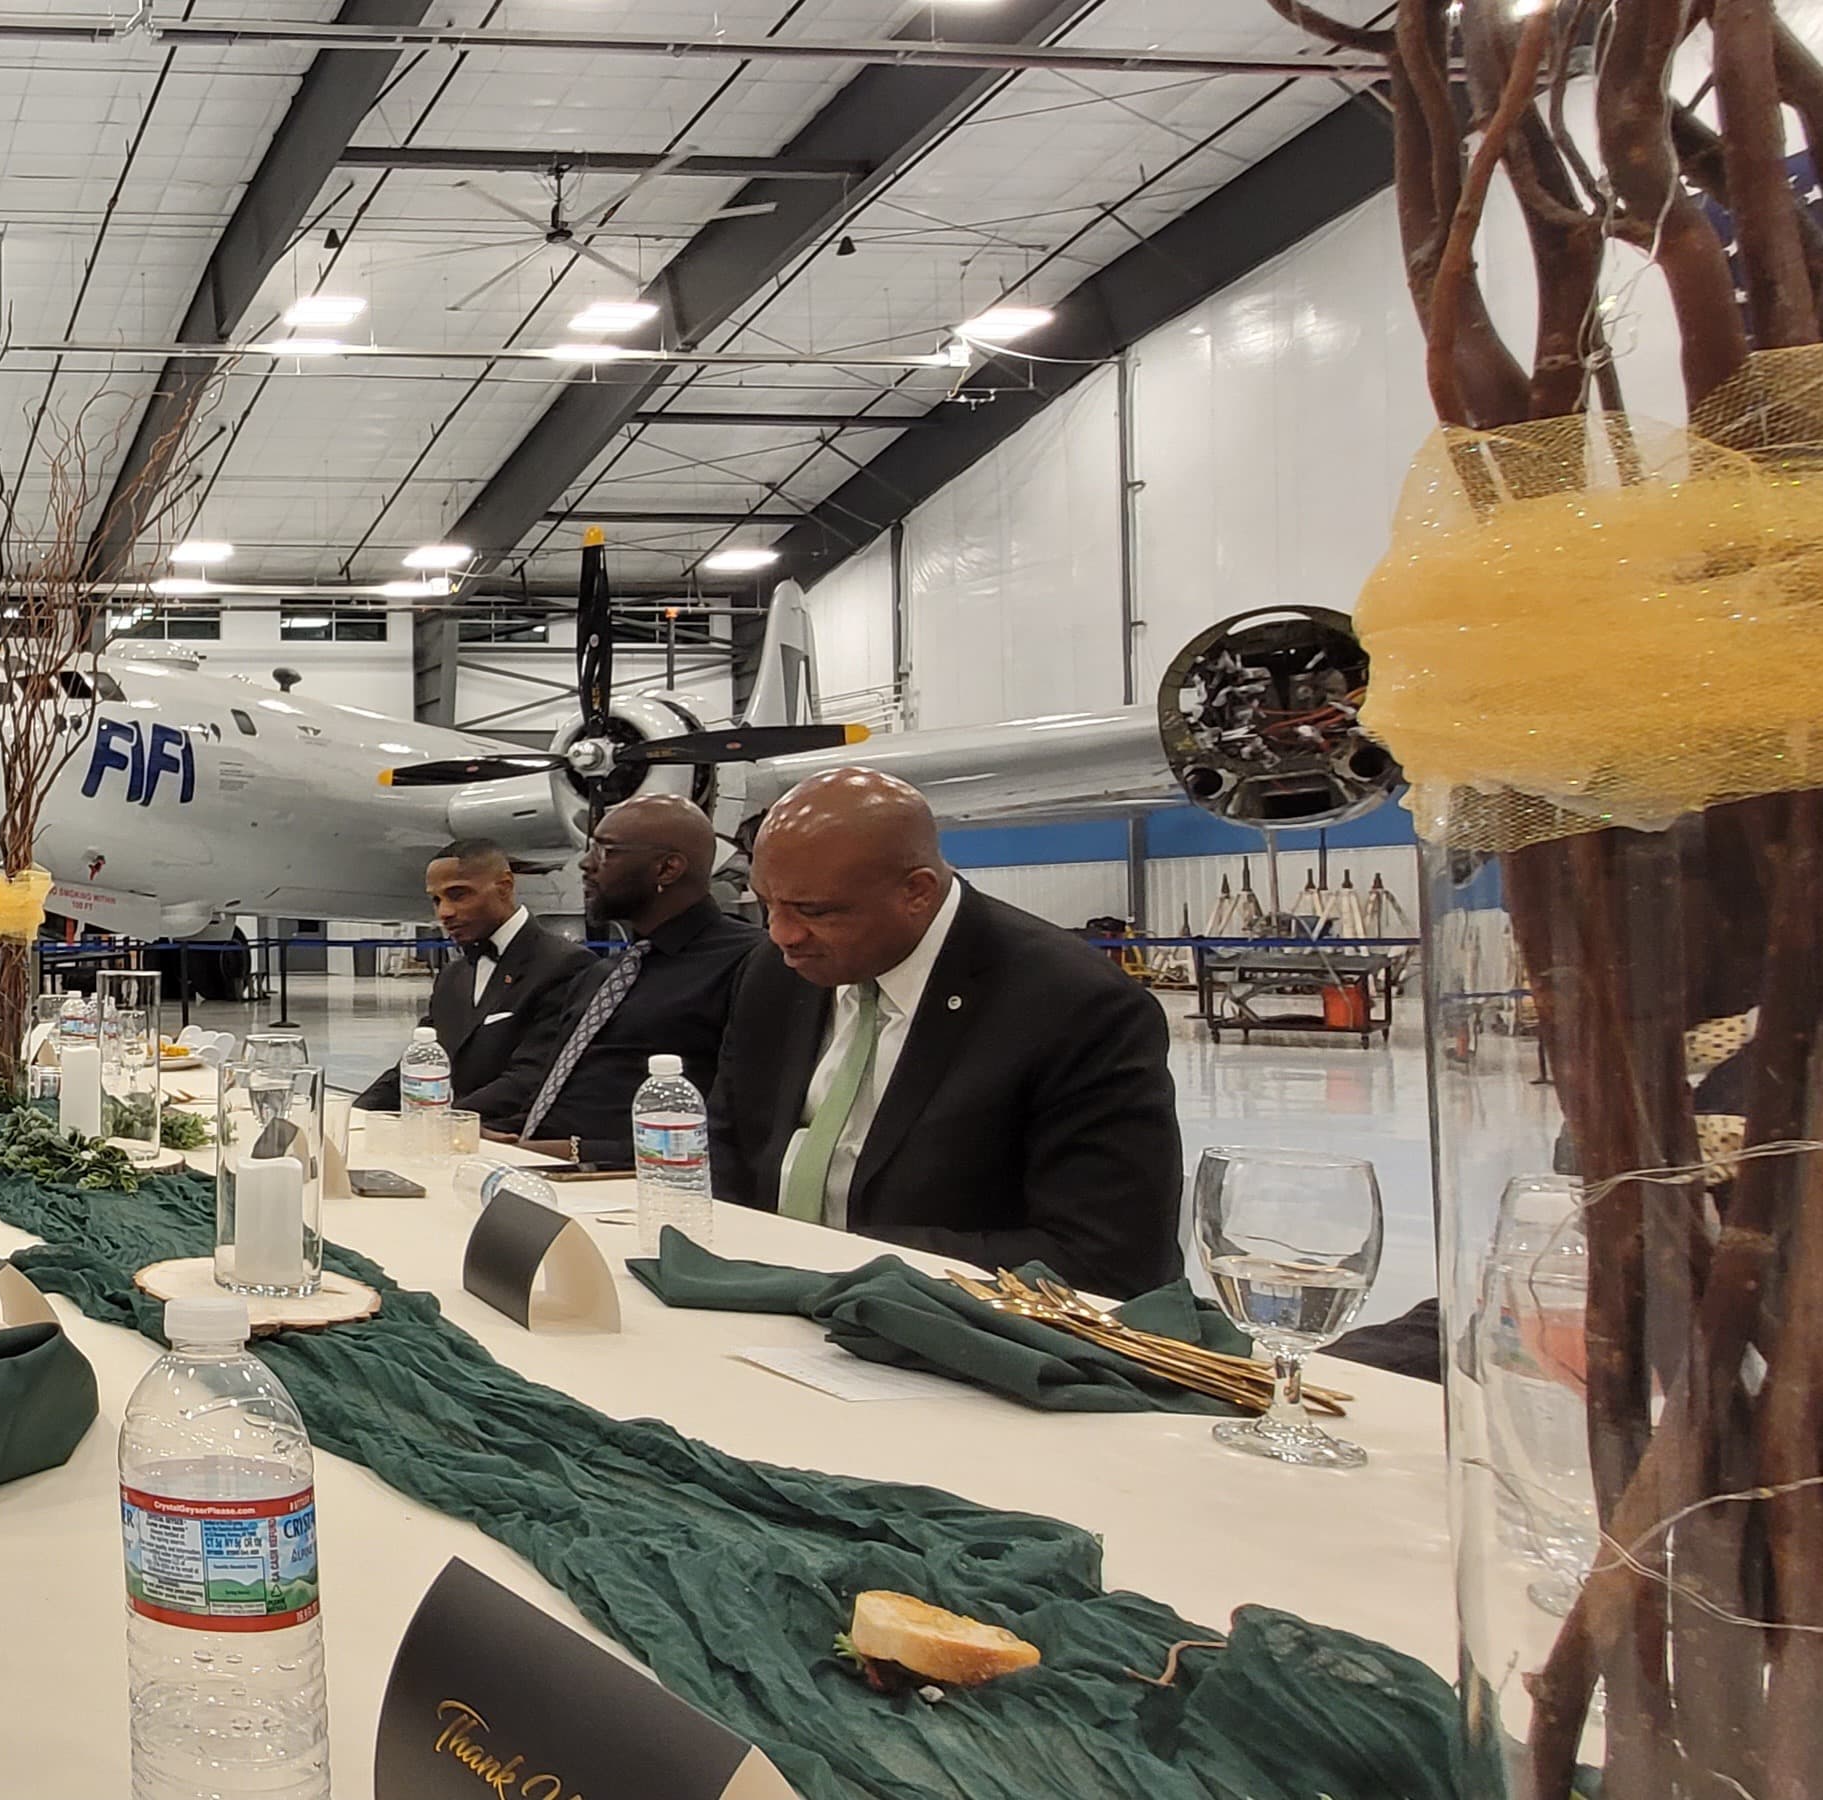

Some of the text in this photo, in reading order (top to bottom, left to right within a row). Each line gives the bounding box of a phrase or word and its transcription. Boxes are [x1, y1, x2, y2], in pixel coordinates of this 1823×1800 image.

[80, 716, 196, 808] FIFI
[59, 887, 92, 901] SMOKING
[93, 895, 116, 905] WITHIN
[84, 902, 94, 911] FT
[436, 1700, 525, 1800] Thank
